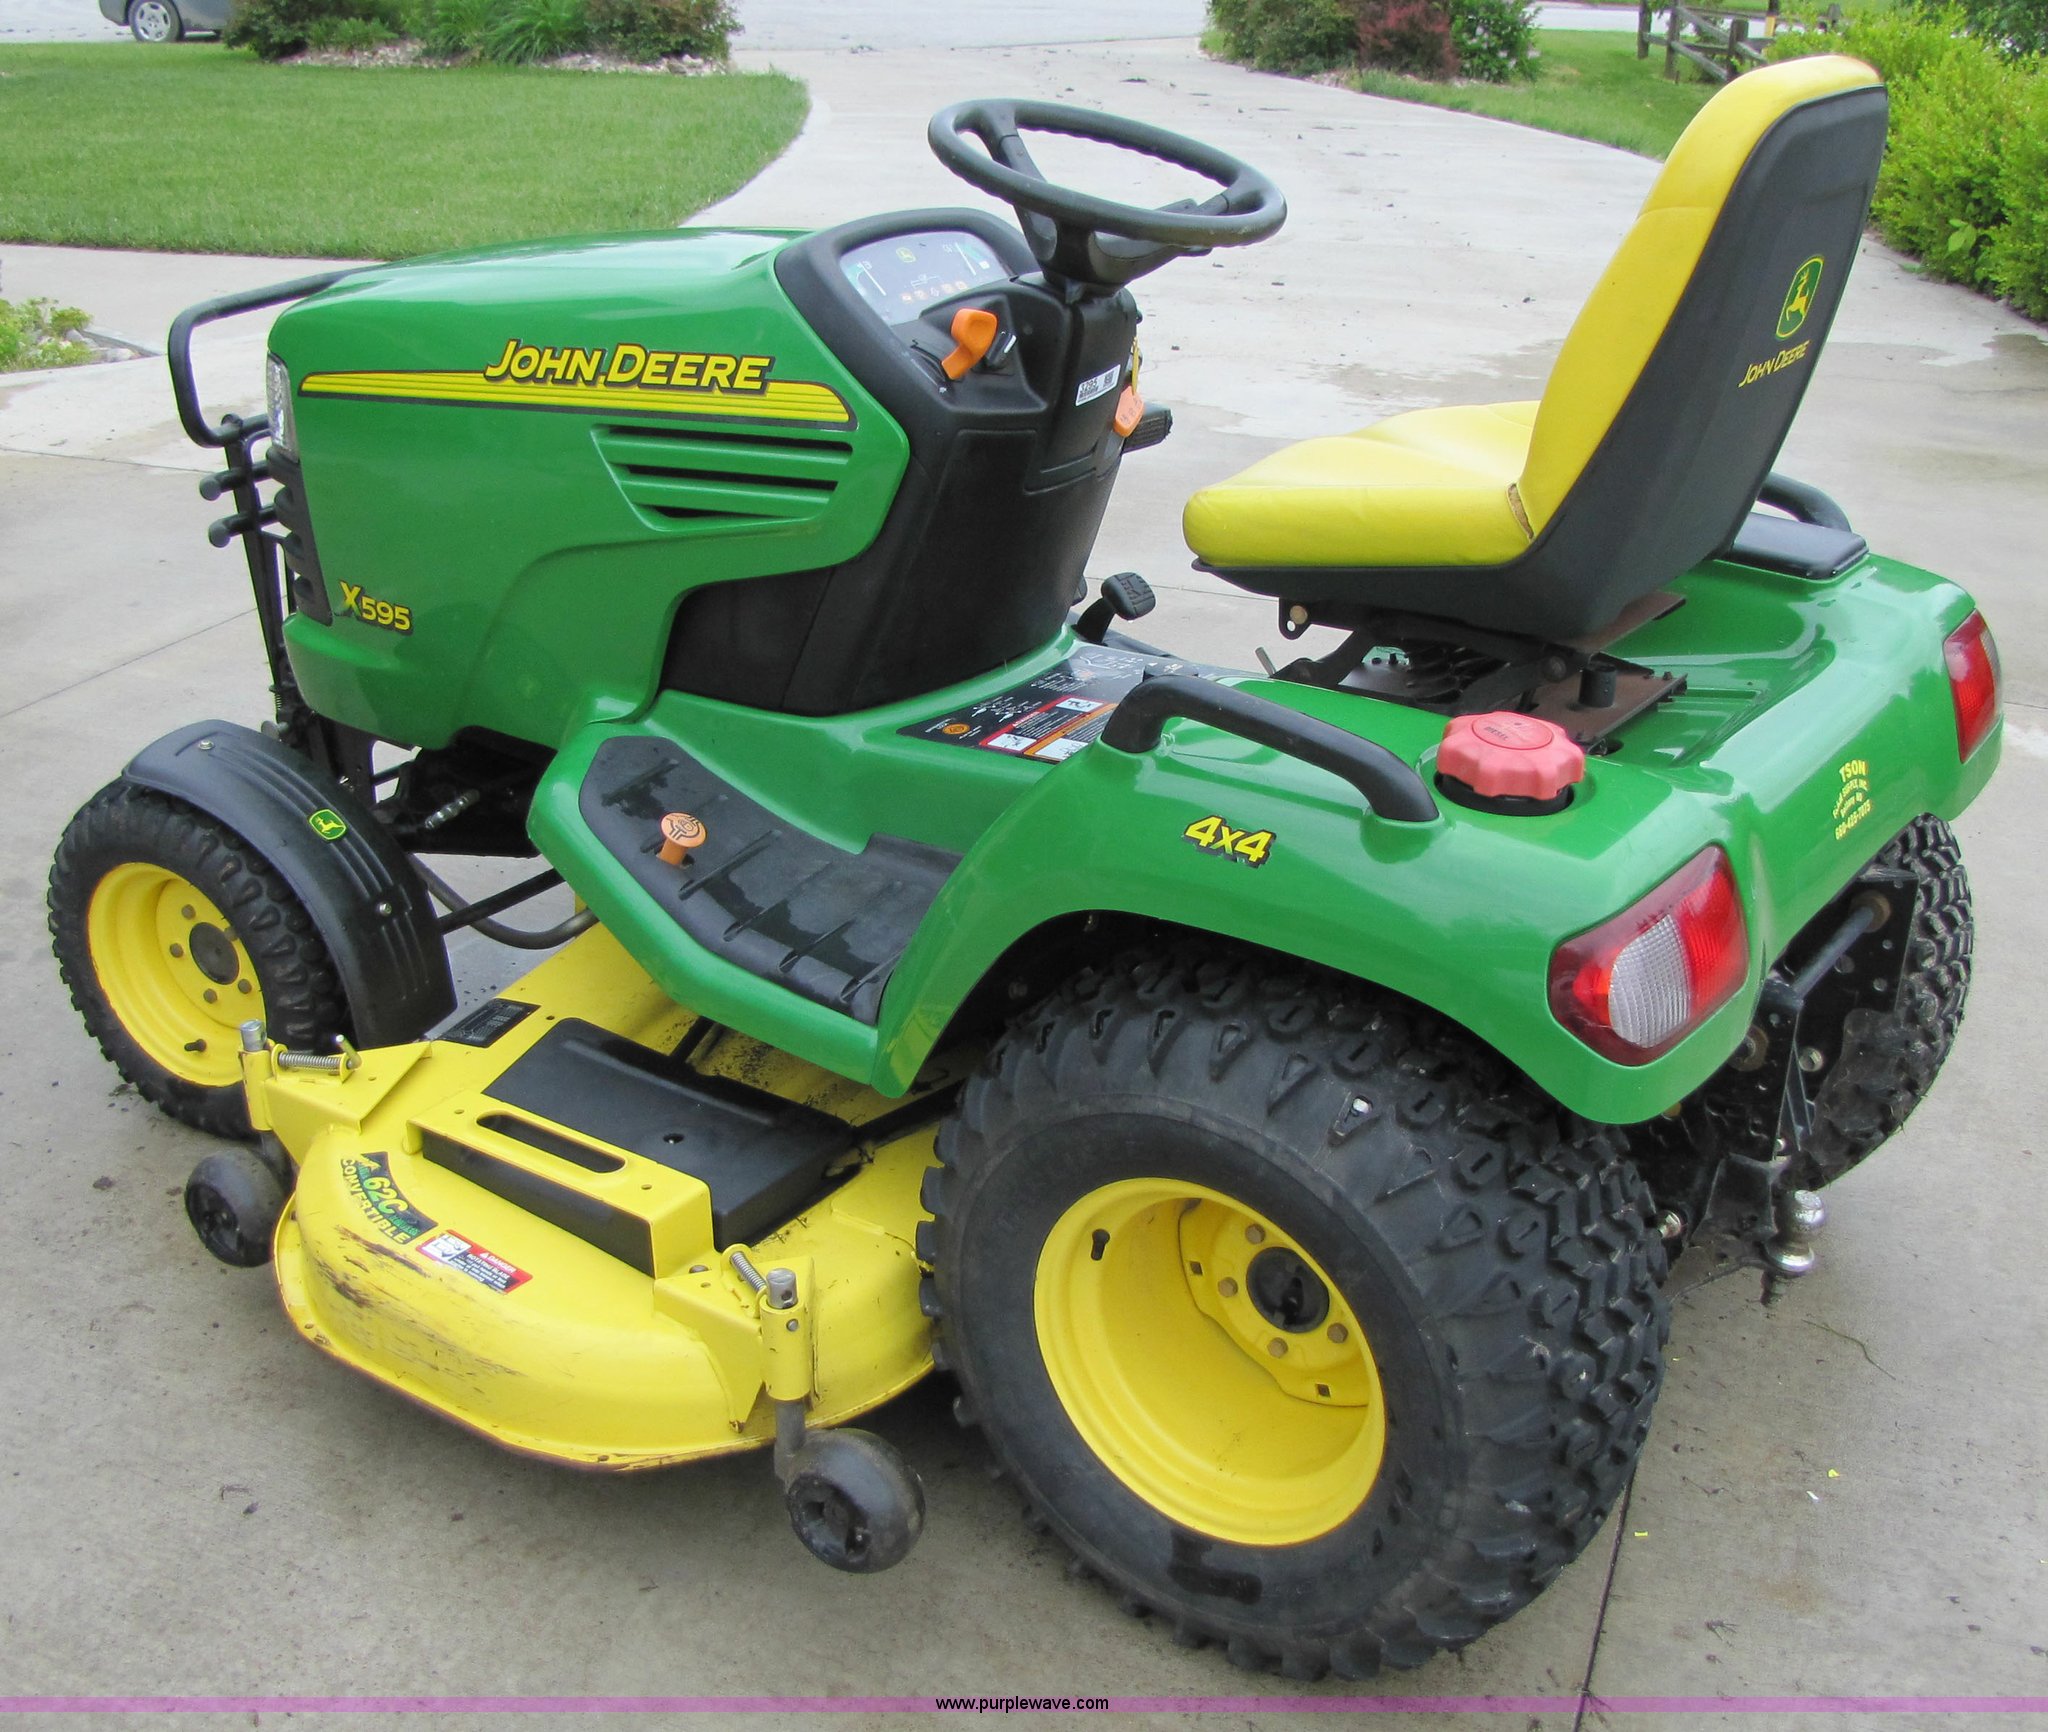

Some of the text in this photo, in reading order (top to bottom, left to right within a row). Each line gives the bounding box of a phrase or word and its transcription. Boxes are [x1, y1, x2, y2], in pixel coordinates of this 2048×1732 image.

[485, 339, 773, 392] JOHN DEERE
[1738, 340, 1810, 387] JOHN DEERE
[339, 580, 413, 633] X595
[1838, 759, 1867, 783] TSON
[341, 1158, 411, 1244] CONVERTIBLE
[362, 1176, 409, 1215] 62C
[488, 1254, 517, 1273] DANGER
